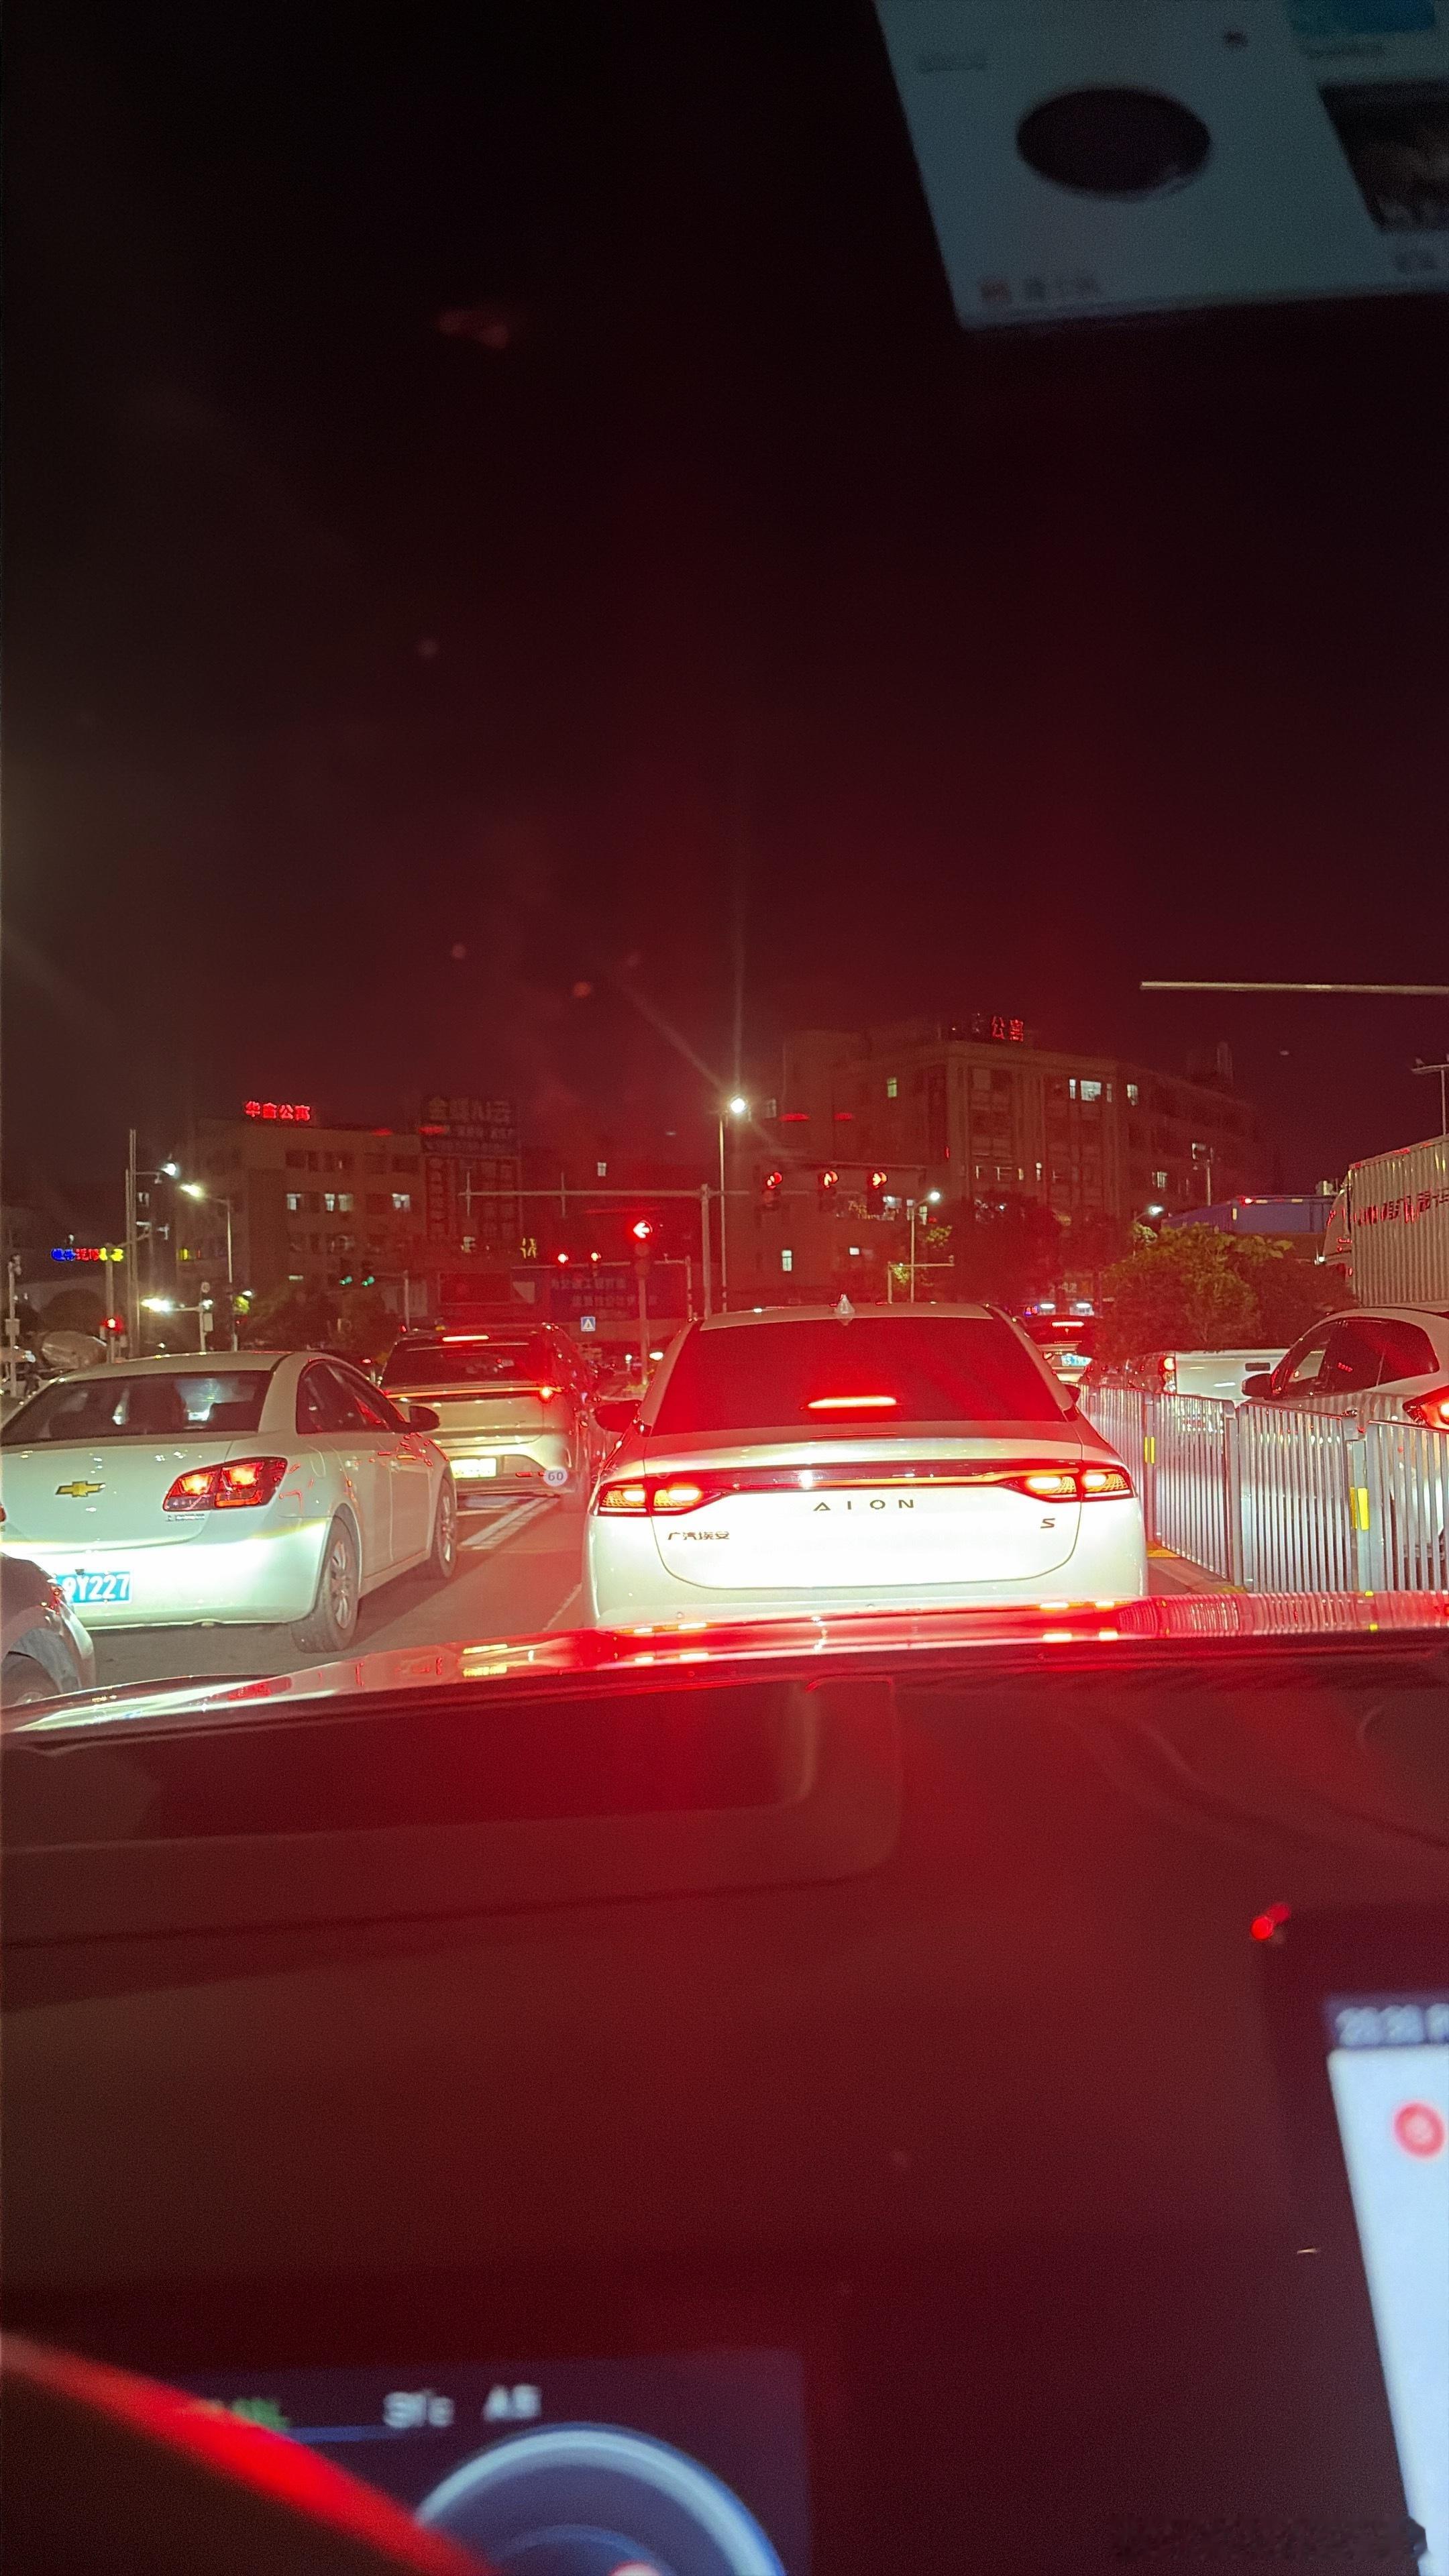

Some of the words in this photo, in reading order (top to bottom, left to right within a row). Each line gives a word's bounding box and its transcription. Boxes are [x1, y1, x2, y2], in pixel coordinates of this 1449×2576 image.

[547, 1470, 564, 1482] 60
[813, 1499, 914, 1511] AION
[1040, 1517, 1056, 1529] S
[667, 1531, 731, 1541] 广汽埃安
